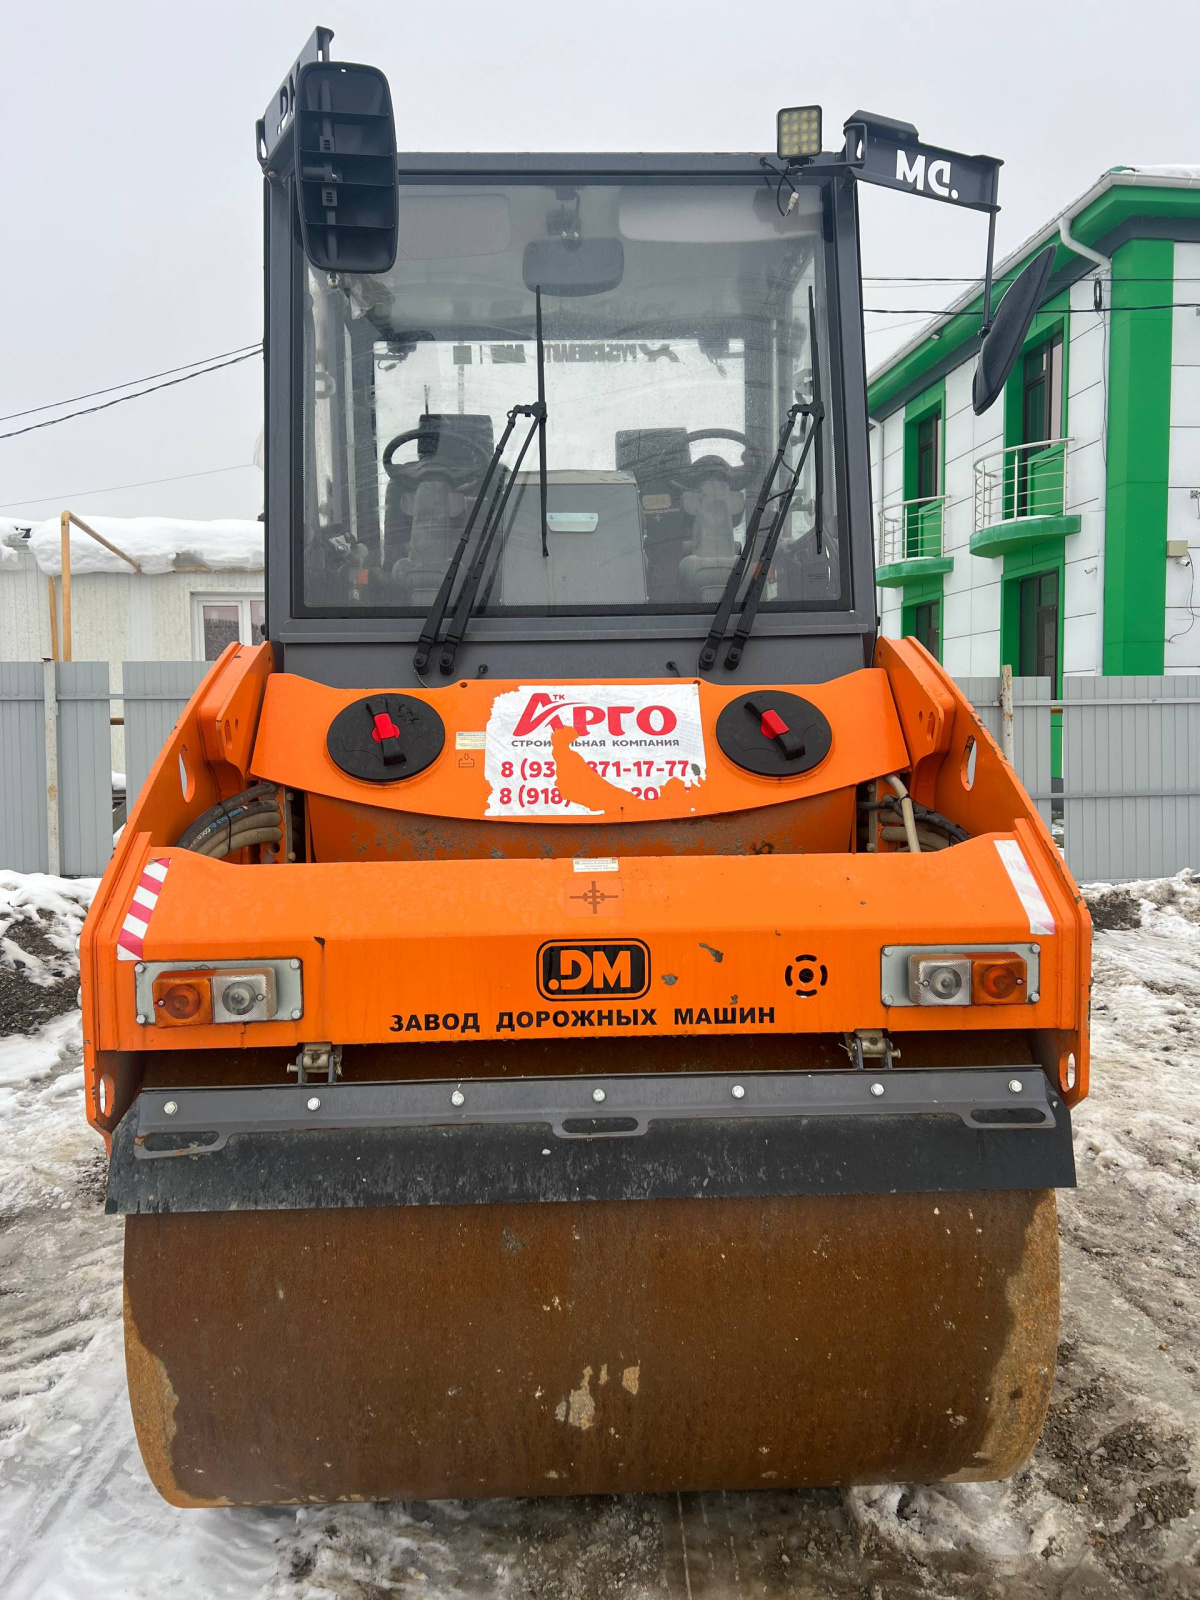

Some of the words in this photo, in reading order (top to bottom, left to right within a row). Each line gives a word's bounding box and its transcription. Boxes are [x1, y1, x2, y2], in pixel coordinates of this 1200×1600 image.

[512, 692, 677, 737] АРГО
[511, 739, 606, 748] СТРОИЬНАЯ
[612, 739, 680, 747] КОМПАНИЯ
[520, 757, 556, 781] (93
[389, 1012, 481, 1034] ЗАВОД
[495, 1009, 658, 1033] ДОРОЖНЫХ
[673, 1006, 776, 1026] МАШИН
